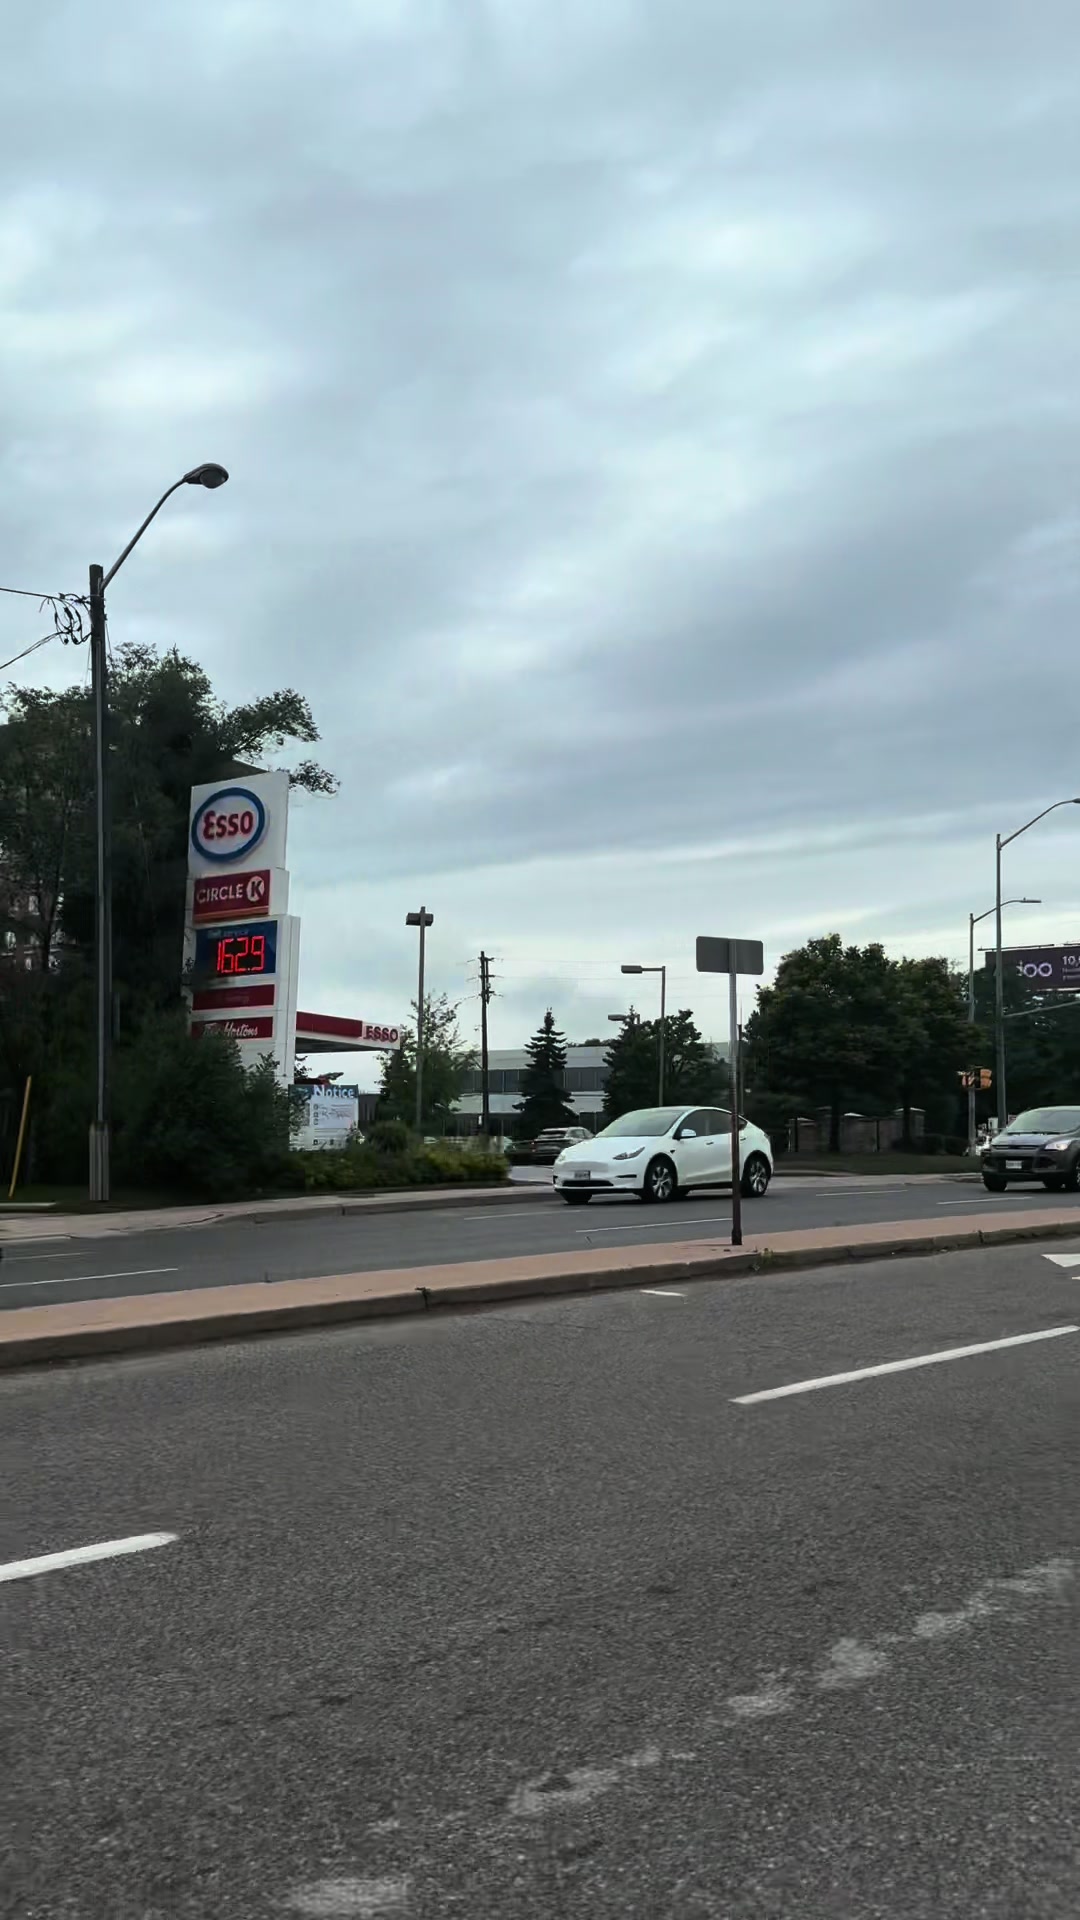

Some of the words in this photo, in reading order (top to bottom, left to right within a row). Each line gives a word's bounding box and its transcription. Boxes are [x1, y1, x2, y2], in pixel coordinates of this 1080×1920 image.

[196, 883, 244, 904] CIRCLE
[250, 878, 264, 900] K
[313, 1084, 354, 1099] Notice
